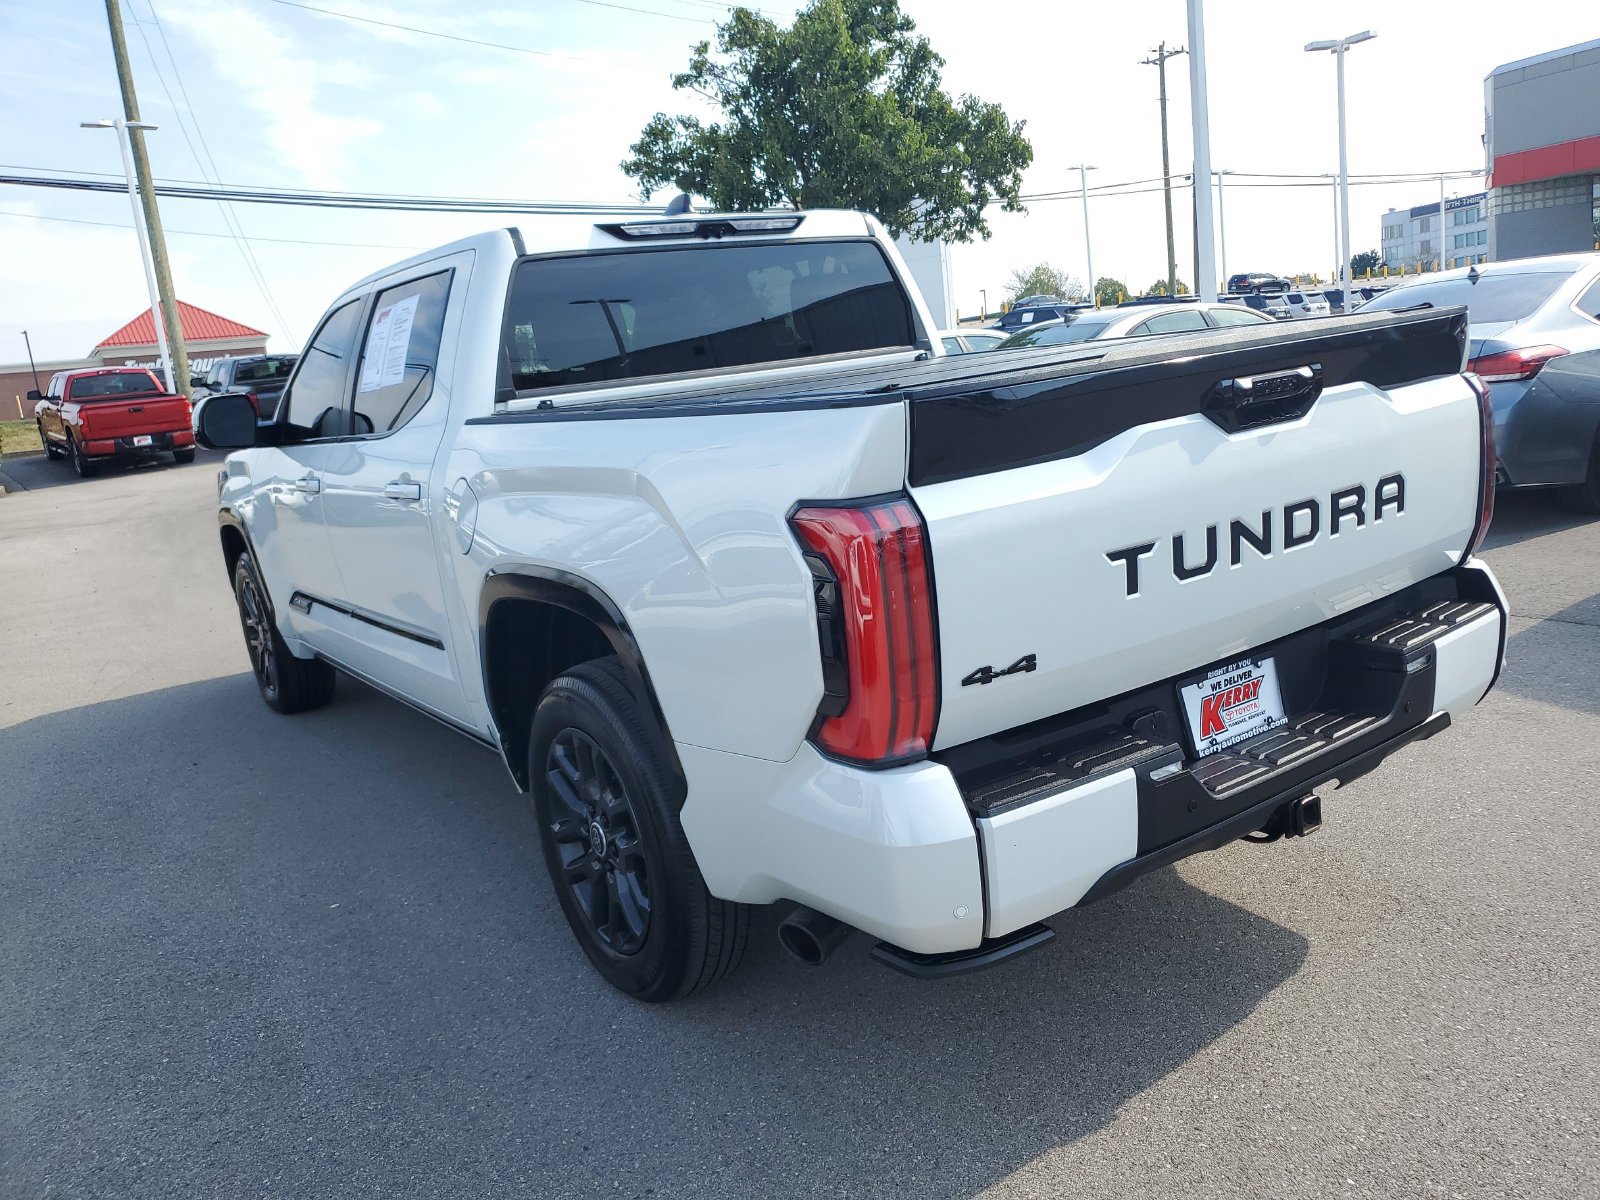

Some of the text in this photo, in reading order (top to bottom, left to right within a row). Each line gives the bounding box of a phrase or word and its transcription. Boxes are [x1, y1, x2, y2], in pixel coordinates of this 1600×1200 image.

[1445, 201, 1461, 209] IFTH
[1104, 472, 1406, 599] TUNDRA
[1207, 658, 1252, 679] RIGHT BY YOU
[1210, 670, 1253, 692] WE DELIVER
[1201, 678, 1263, 739] KERRY
[1234, 702, 1259, 716] TOYOTA
[1198, 716, 1289, 759] kerryautomotive.com
